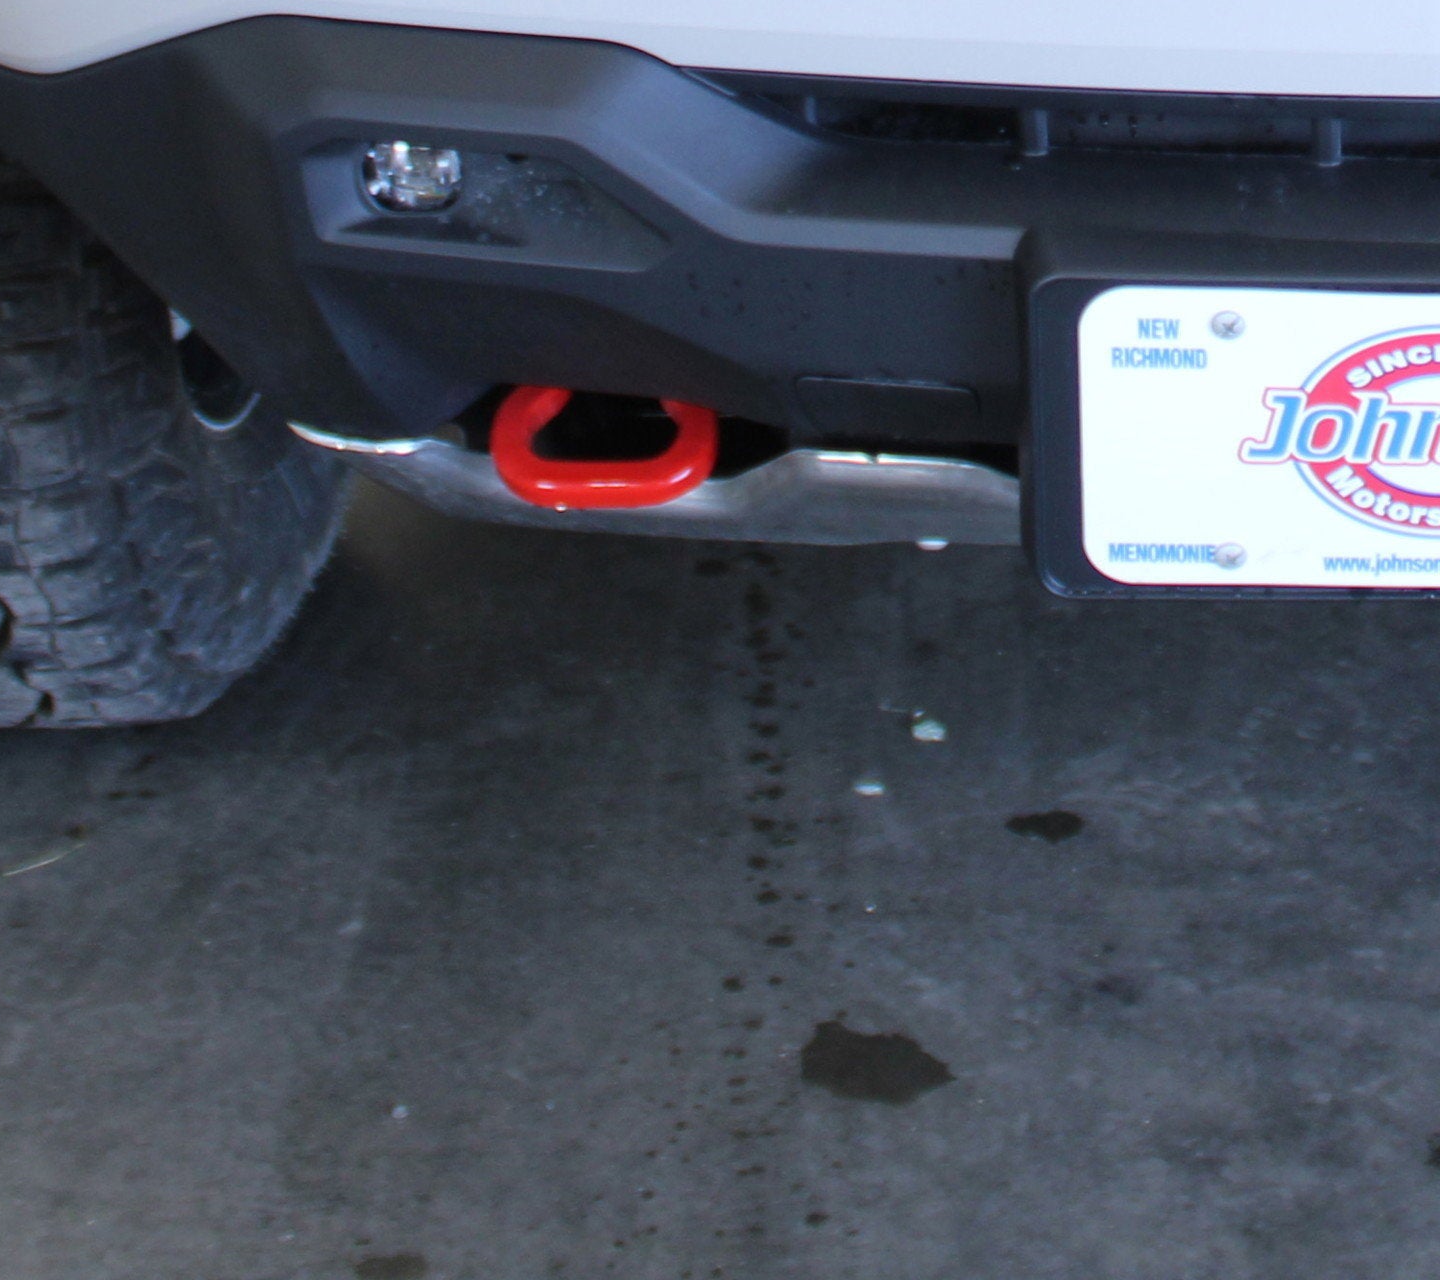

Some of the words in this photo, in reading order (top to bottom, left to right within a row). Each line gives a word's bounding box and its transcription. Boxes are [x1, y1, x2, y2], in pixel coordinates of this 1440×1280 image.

[1137, 318, 1180, 339] NEW
[1111, 347, 1208, 369] RICHMOND
[1109, 543, 1217, 563] MENOMONIE
